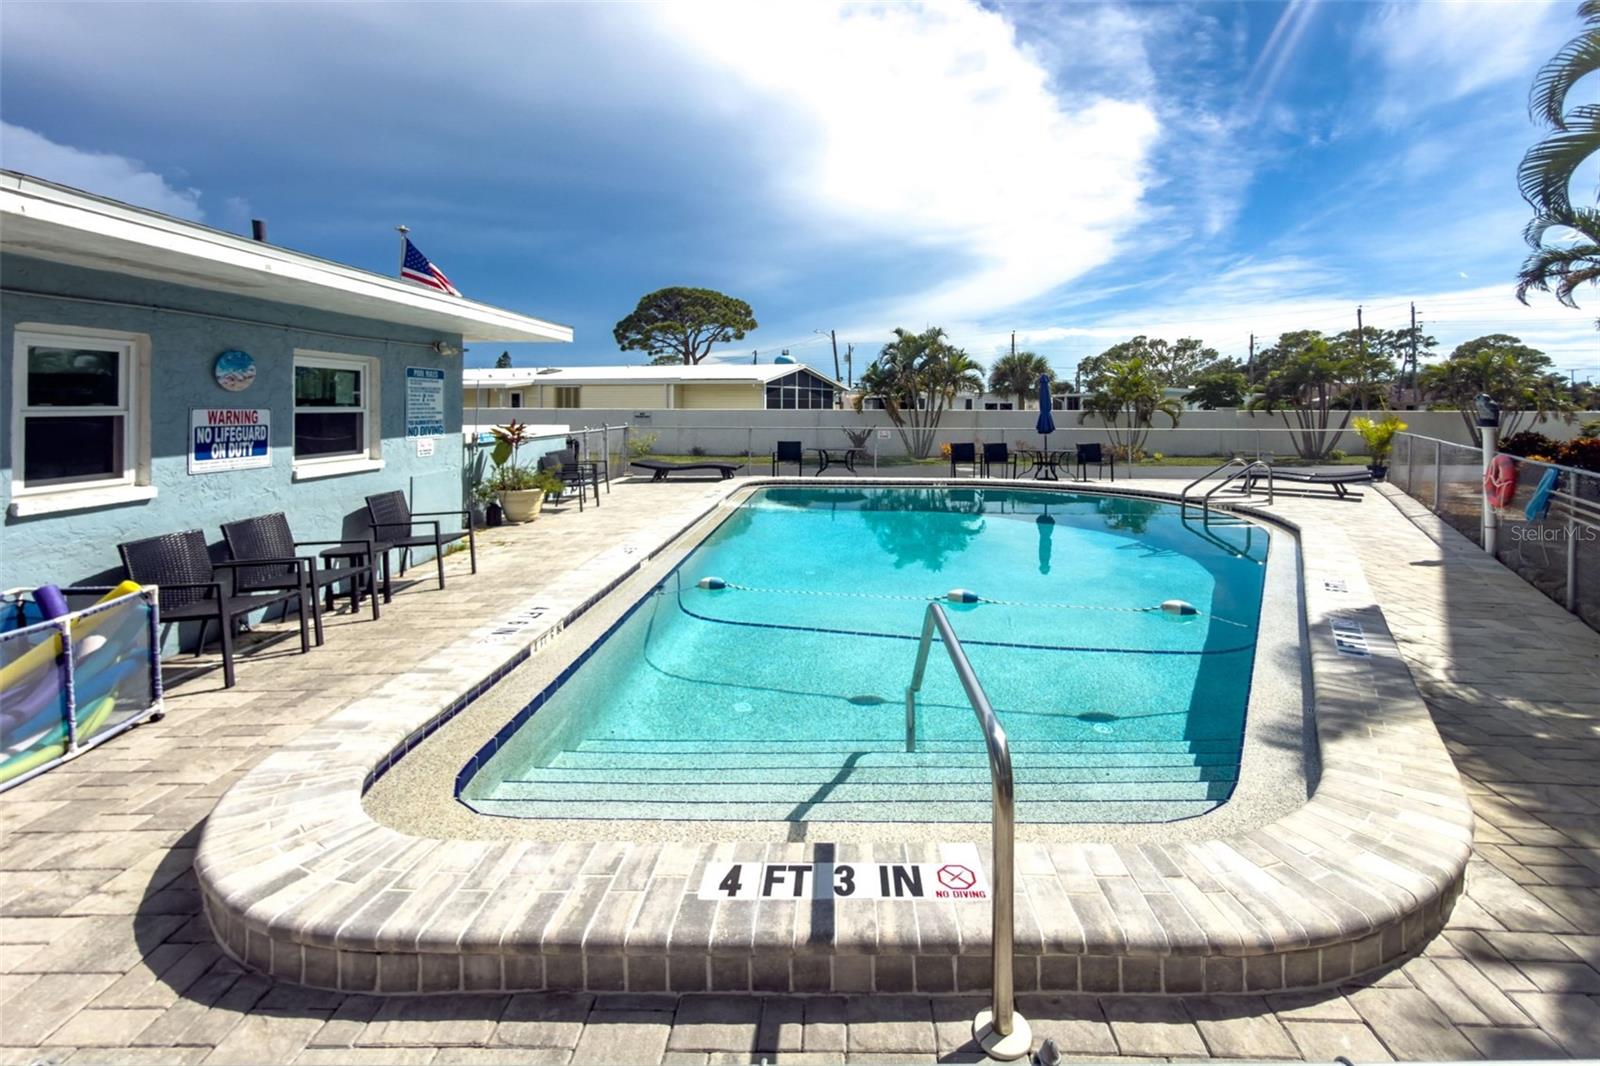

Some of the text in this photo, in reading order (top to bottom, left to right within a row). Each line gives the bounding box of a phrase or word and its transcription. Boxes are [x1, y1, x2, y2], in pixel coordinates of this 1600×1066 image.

[208, 410, 258, 425] WARNING
[196, 426, 267, 444] NO LIFEGUARD
[408, 424, 444, 437] NO DIVING
[211, 441, 254, 459] ON DUTY
[718, 864, 924, 897] 4 FT 3 IN
[935, 890, 987, 898] NO DIVING
